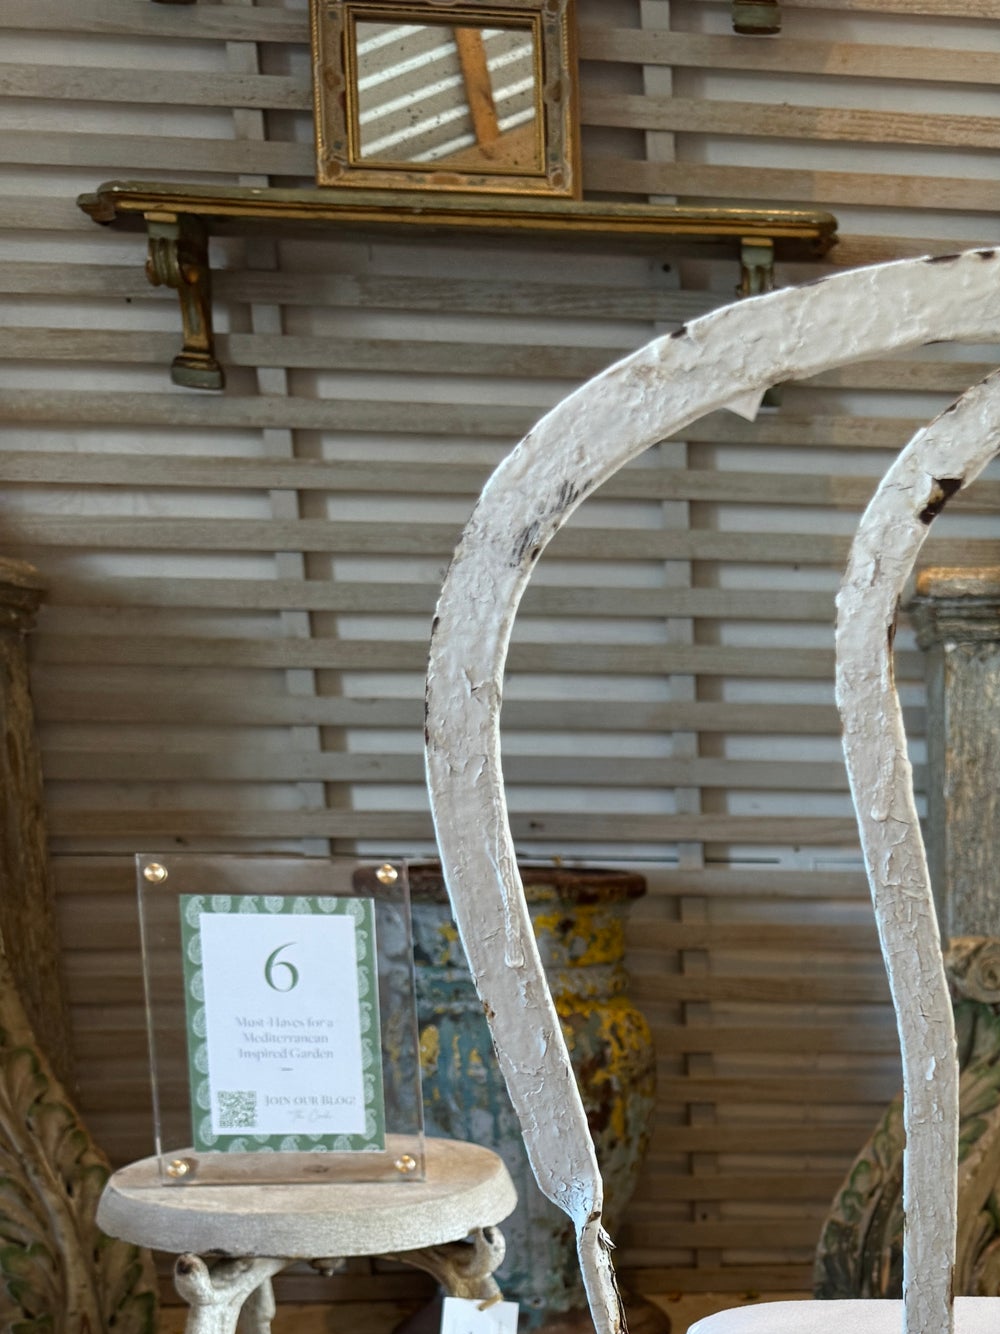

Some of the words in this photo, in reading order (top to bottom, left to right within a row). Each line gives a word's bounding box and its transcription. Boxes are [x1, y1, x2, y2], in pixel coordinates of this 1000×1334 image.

[265, 941, 299, 992] 6
[307, 1016, 325, 1028] for
[327, 1019, 334, 1028] a
[243, 1031, 329, 1044] Mediterranean
[239, 1047, 288, 1061] Inspired
[289, 1047, 334, 1059] Garden
